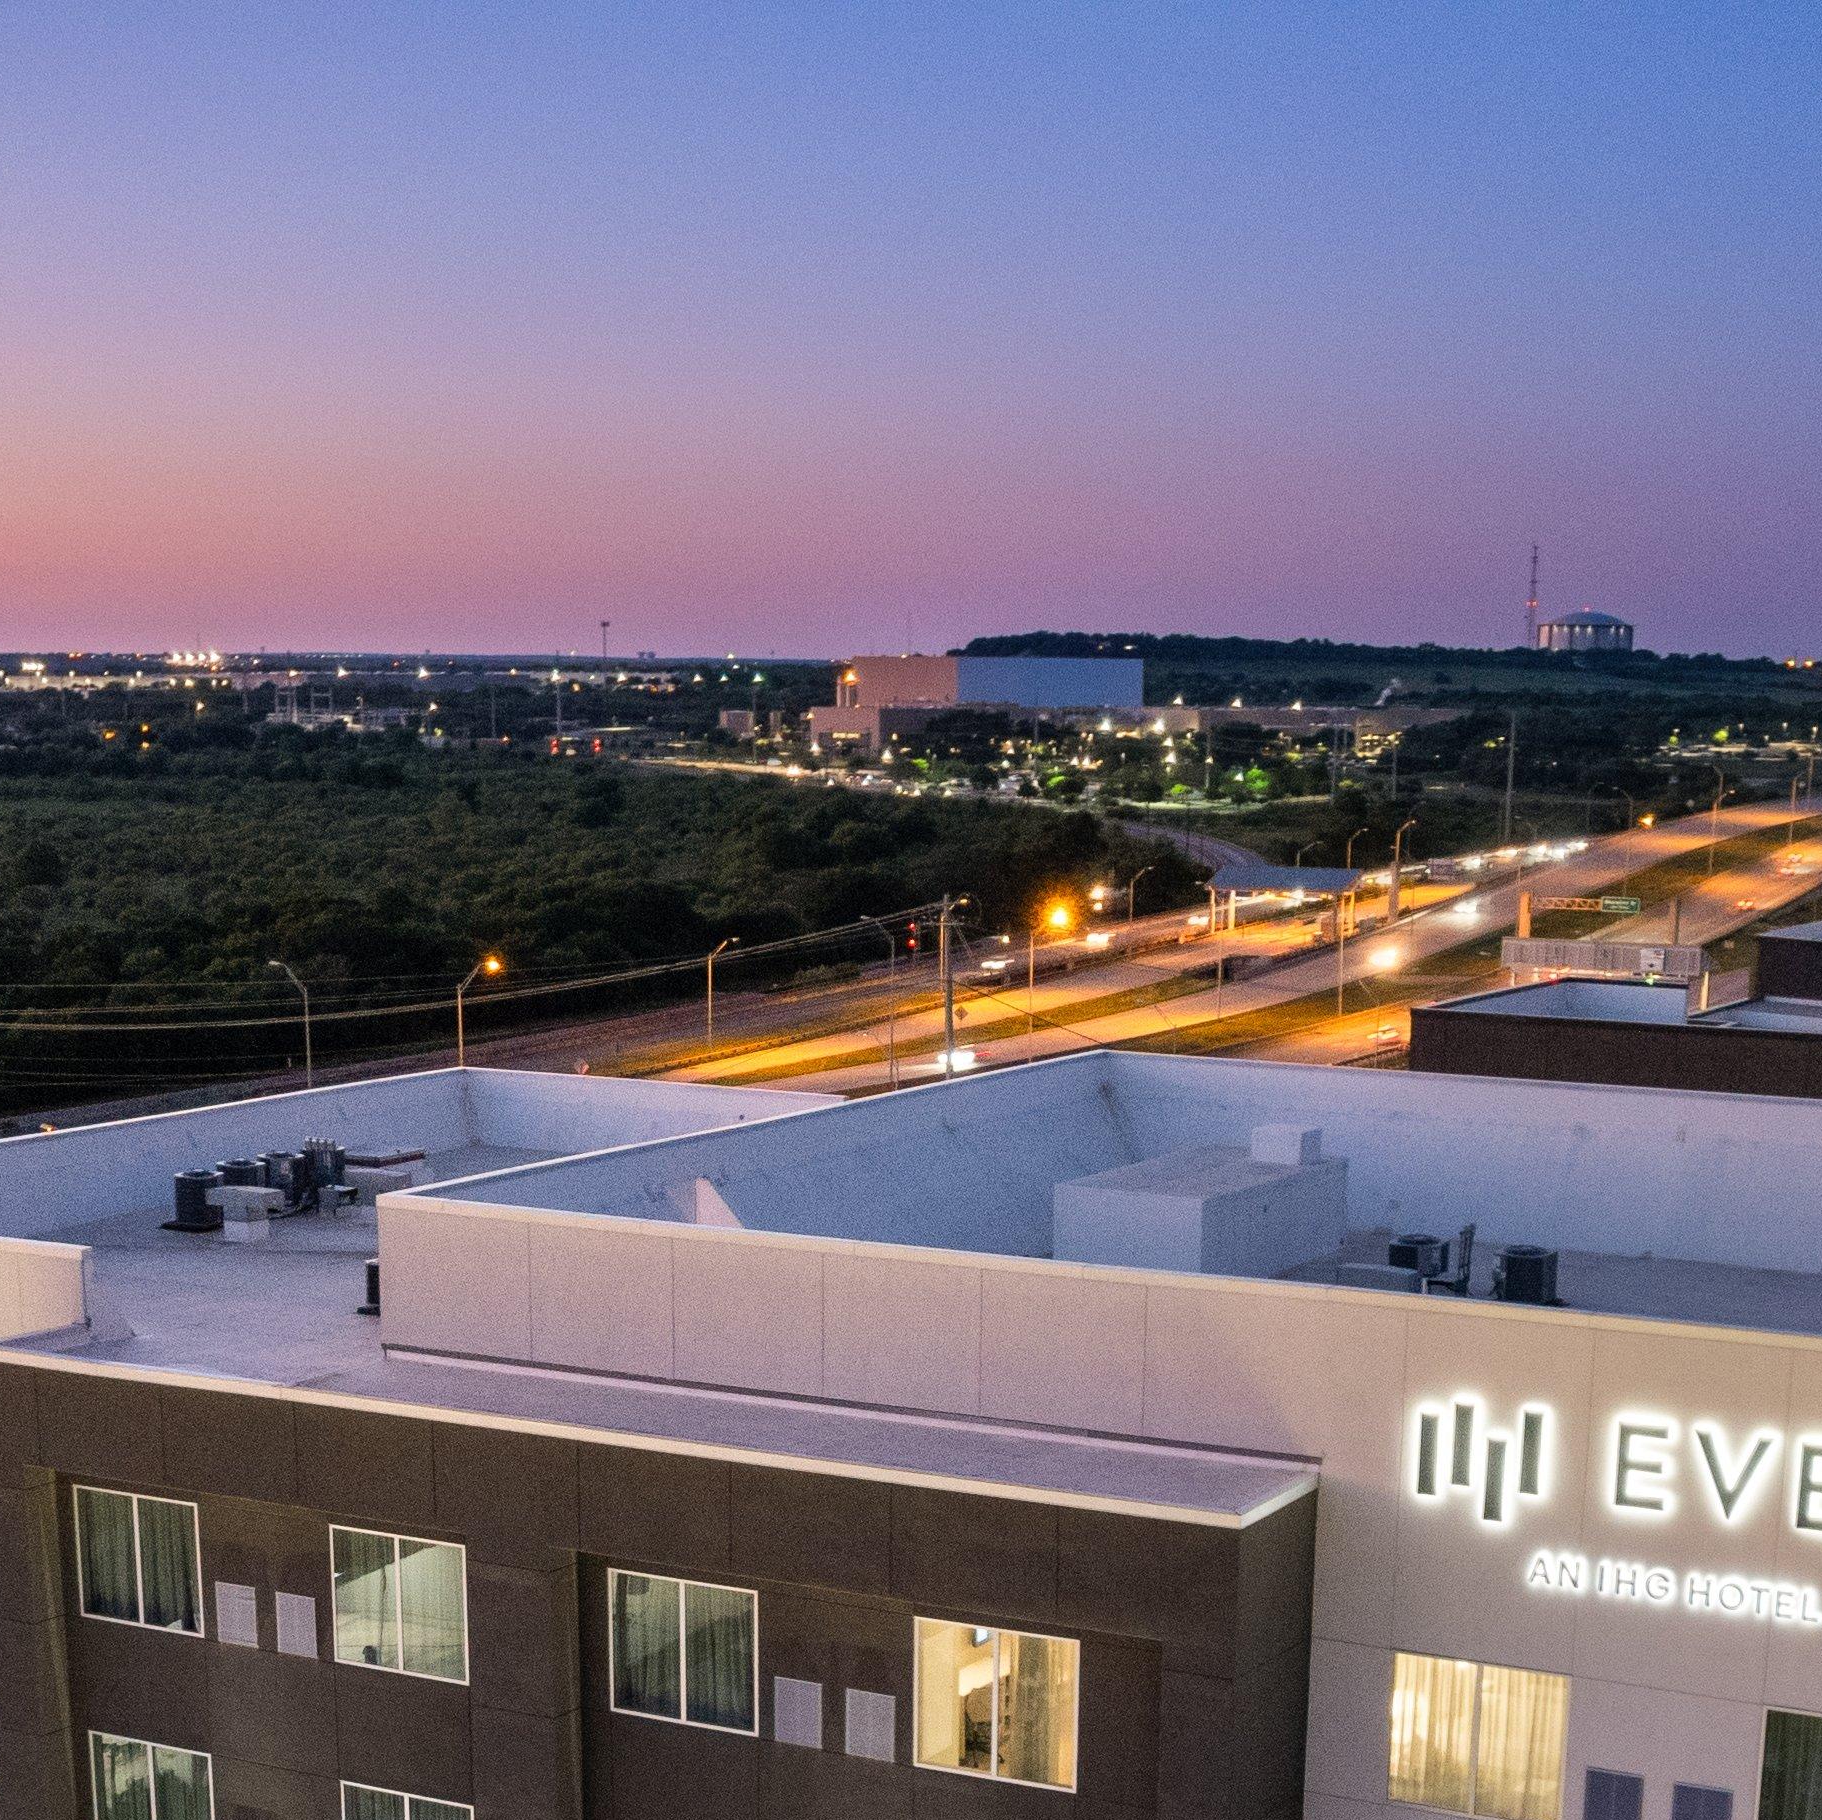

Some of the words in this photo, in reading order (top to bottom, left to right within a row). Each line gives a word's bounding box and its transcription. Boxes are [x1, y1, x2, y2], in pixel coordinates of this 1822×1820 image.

[1526, 1556, 1582, 1591] AN
[1595, 1563, 1671, 1601] IHG
[1686, 1575, 1821, 1623] HOTEL
